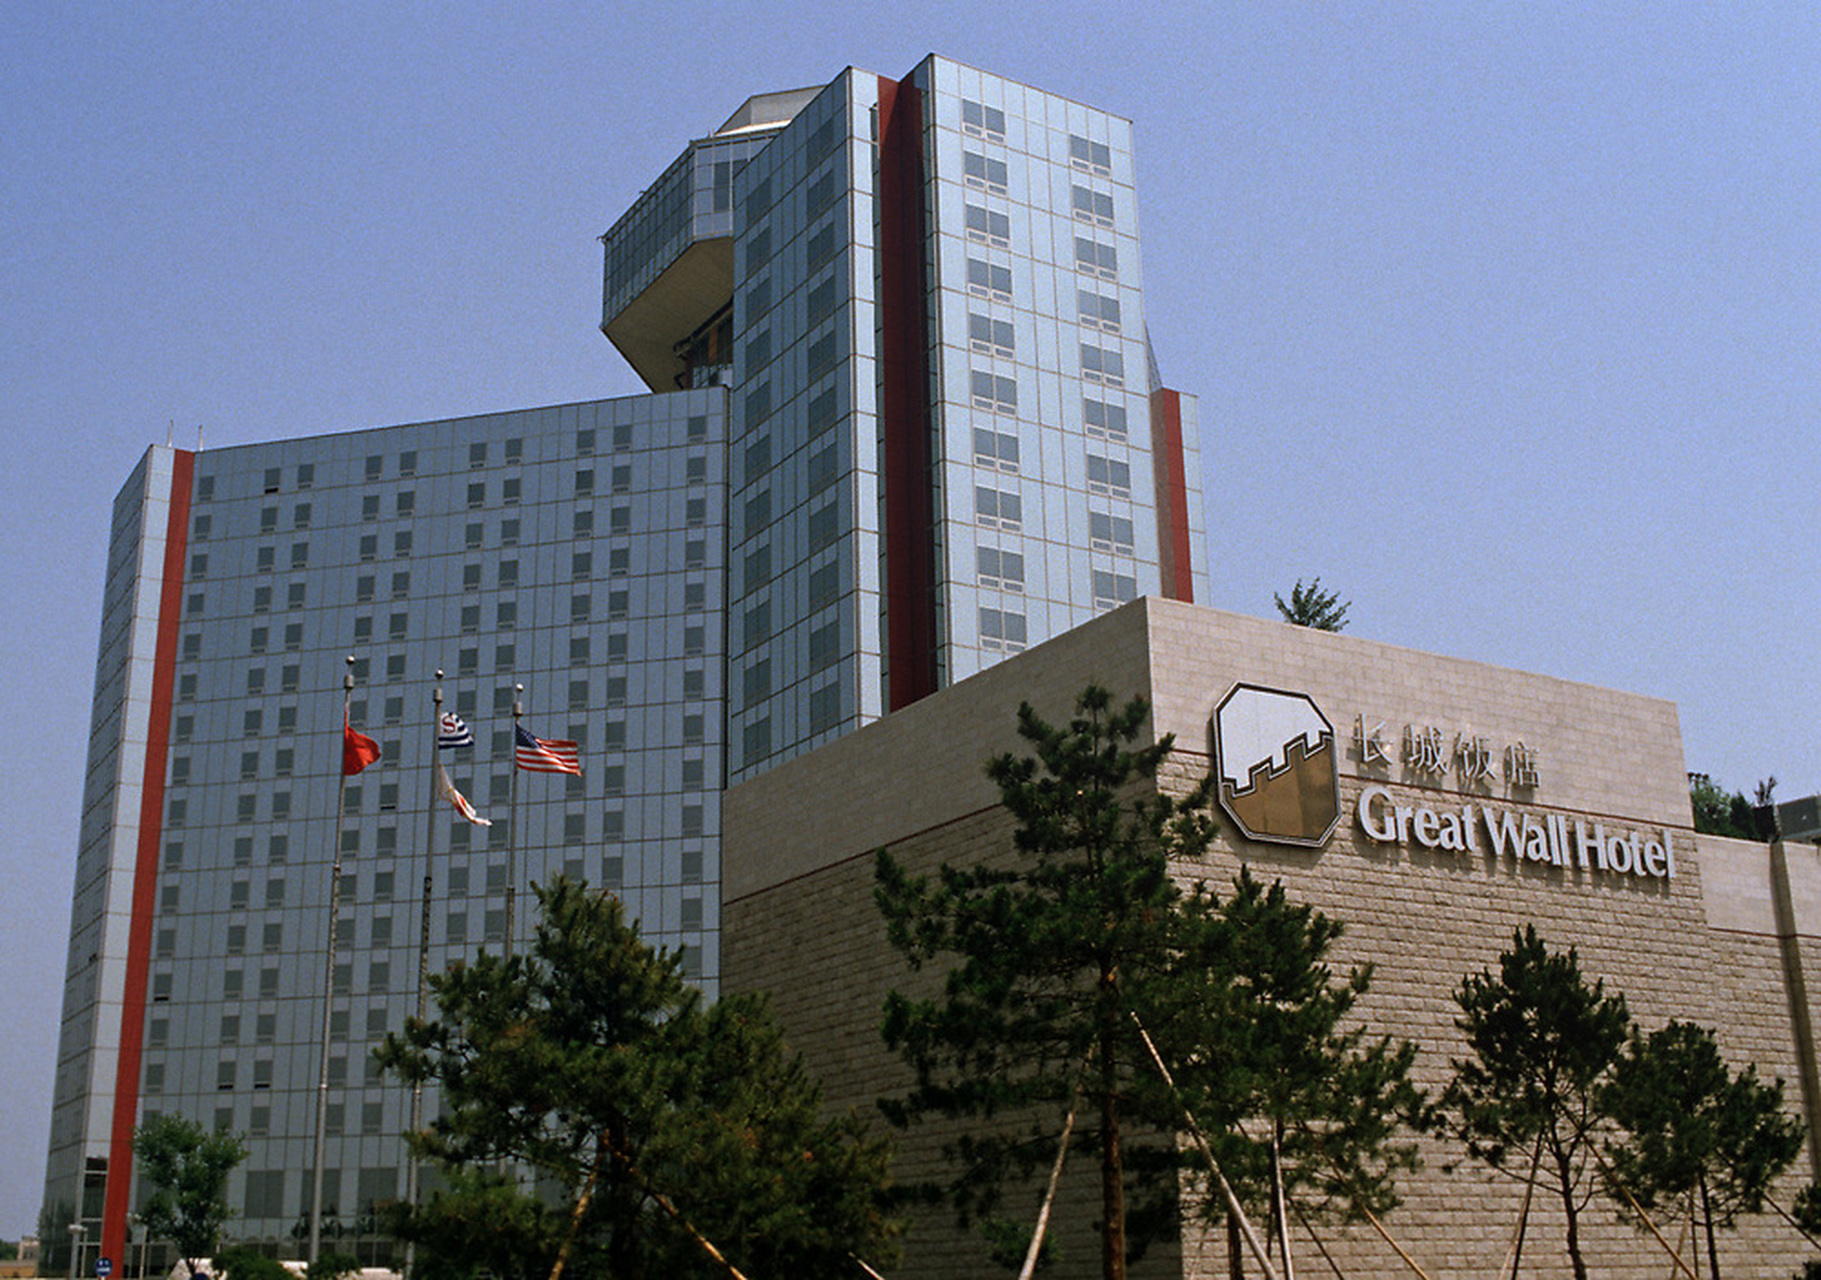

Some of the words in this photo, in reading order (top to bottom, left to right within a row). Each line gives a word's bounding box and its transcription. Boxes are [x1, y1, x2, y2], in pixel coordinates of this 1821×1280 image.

[441, 715, 456, 733] S
[1353, 713, 1539, 788] 长城饭店
[1358, 787, 1477, 852] Great
[1482, 806, 1570, 866] Wall
[1575, 820, 1675, 878] Hotel
